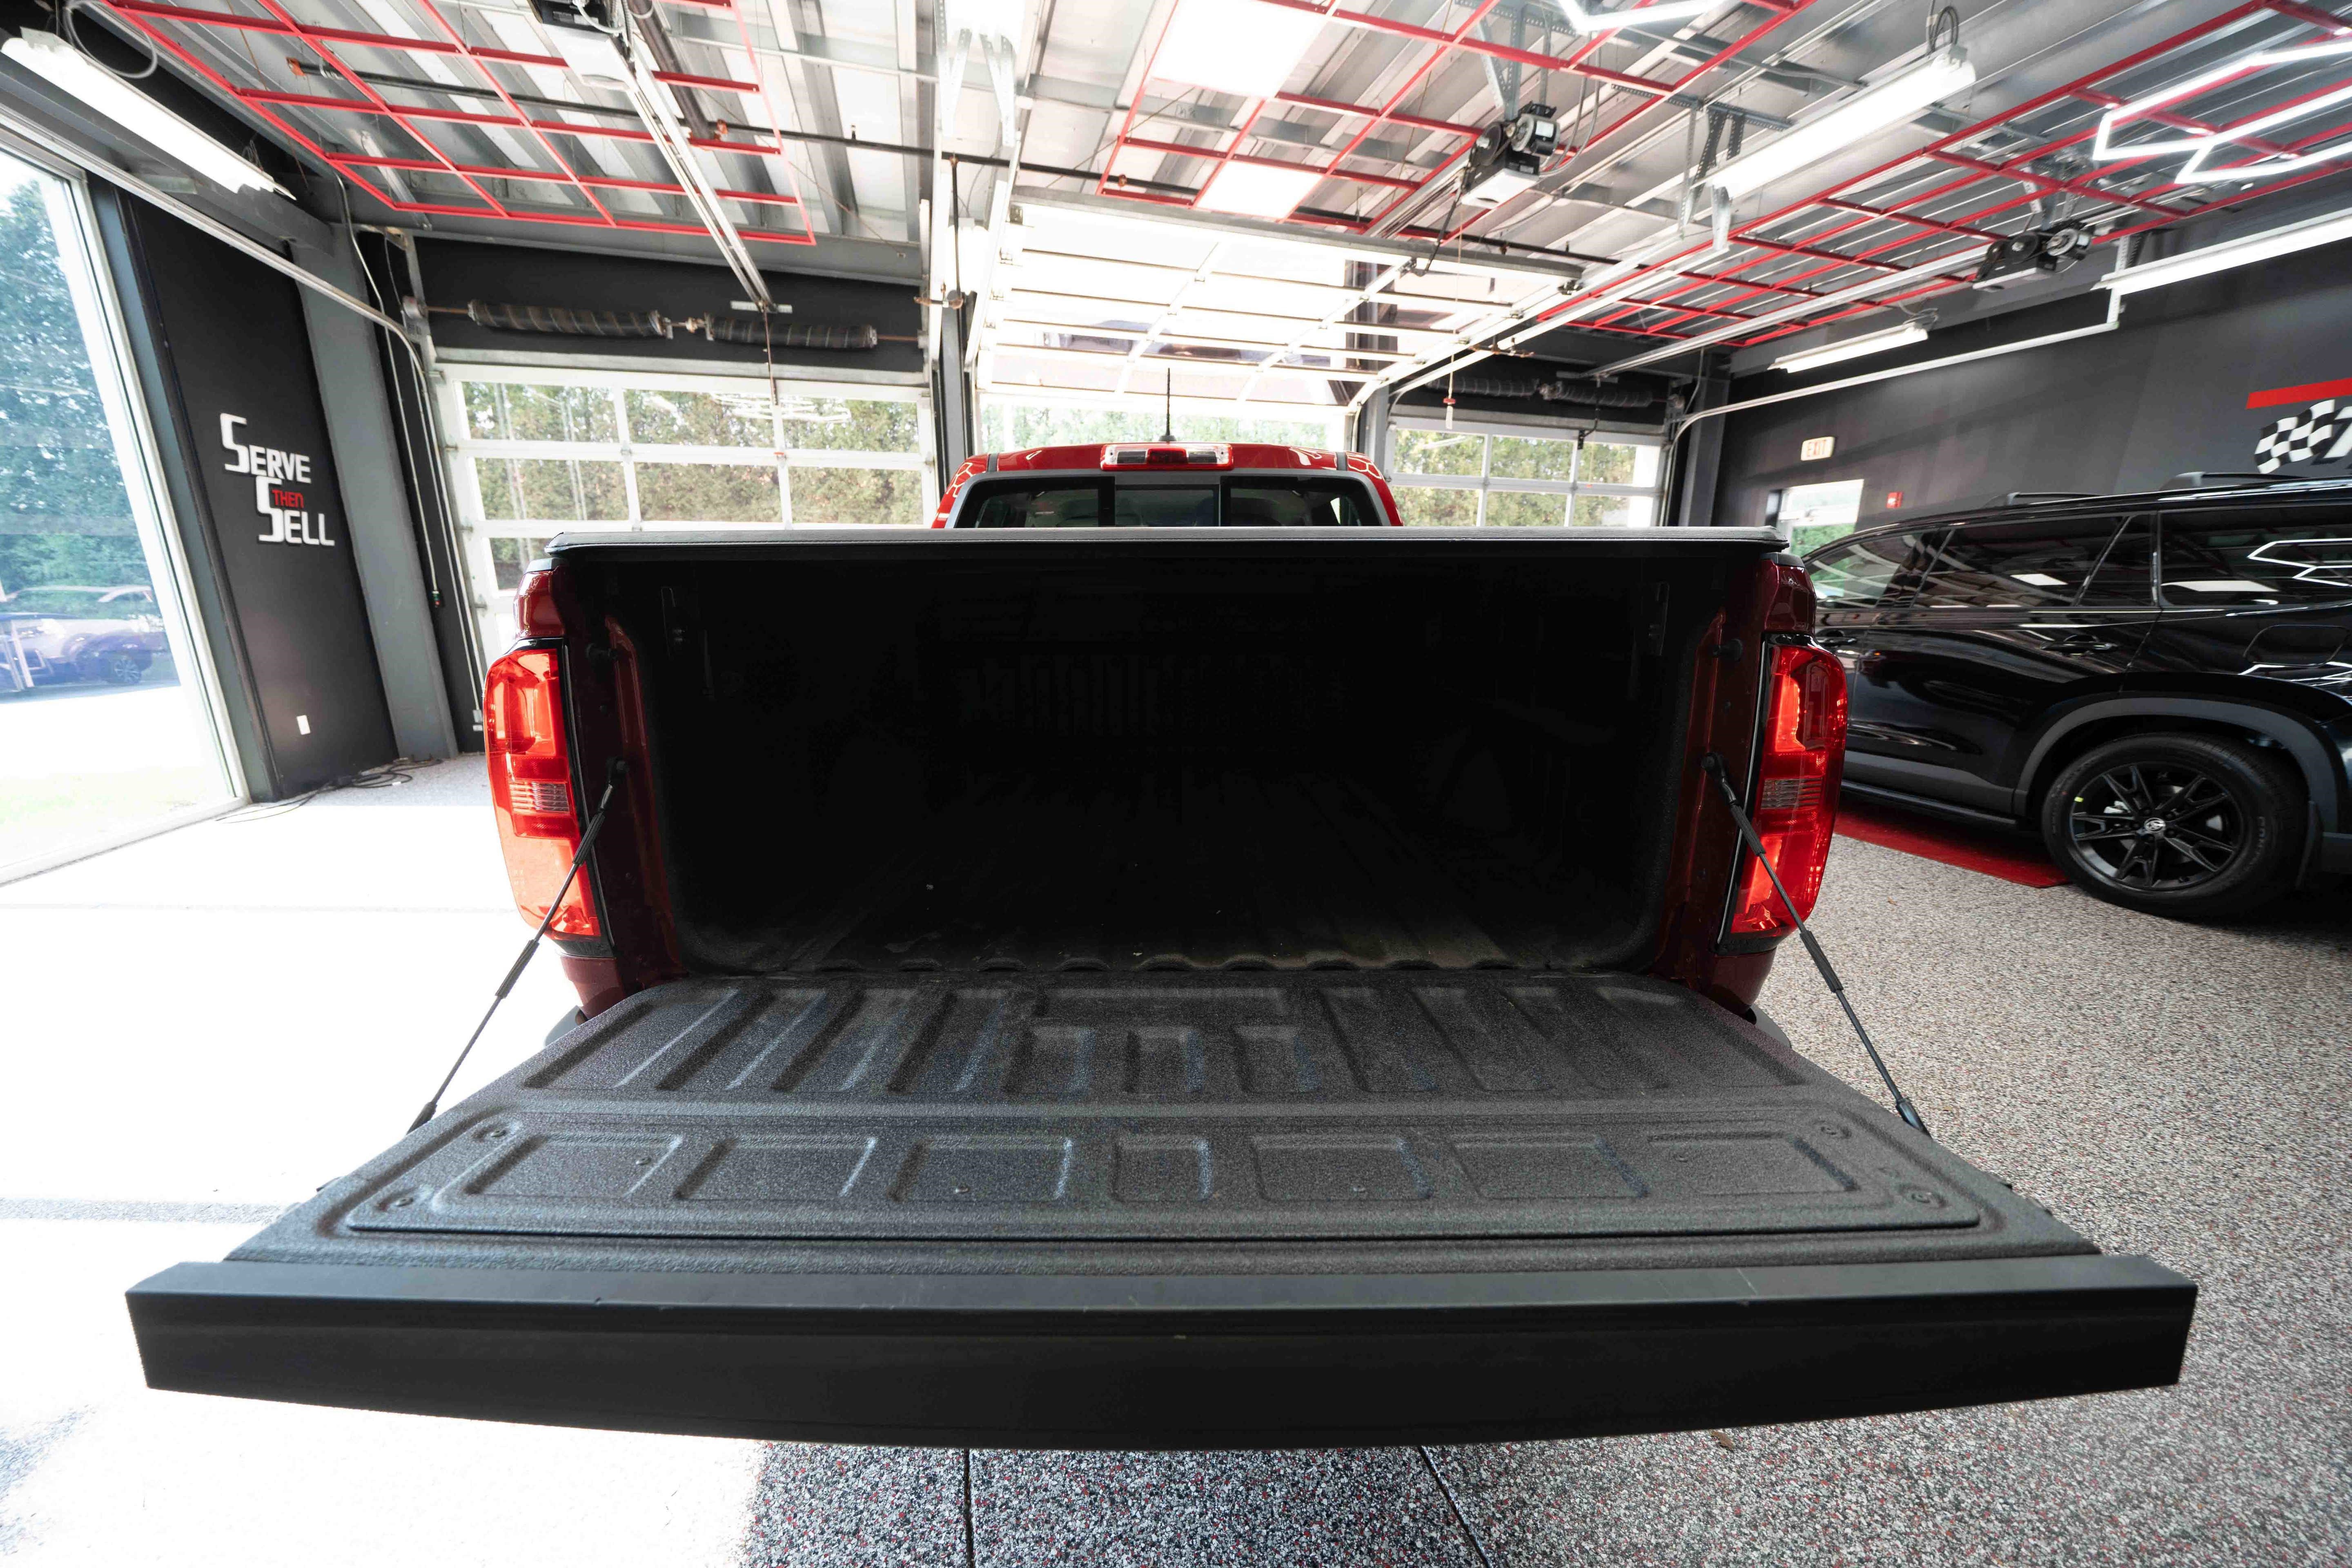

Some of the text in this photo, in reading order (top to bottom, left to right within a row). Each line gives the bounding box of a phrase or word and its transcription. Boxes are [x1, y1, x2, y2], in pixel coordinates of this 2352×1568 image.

[220, 413, 312, 483] SERVE
[1806, 439, 1827, 457] EXIT
[256, 475, 335, 546] SELL
